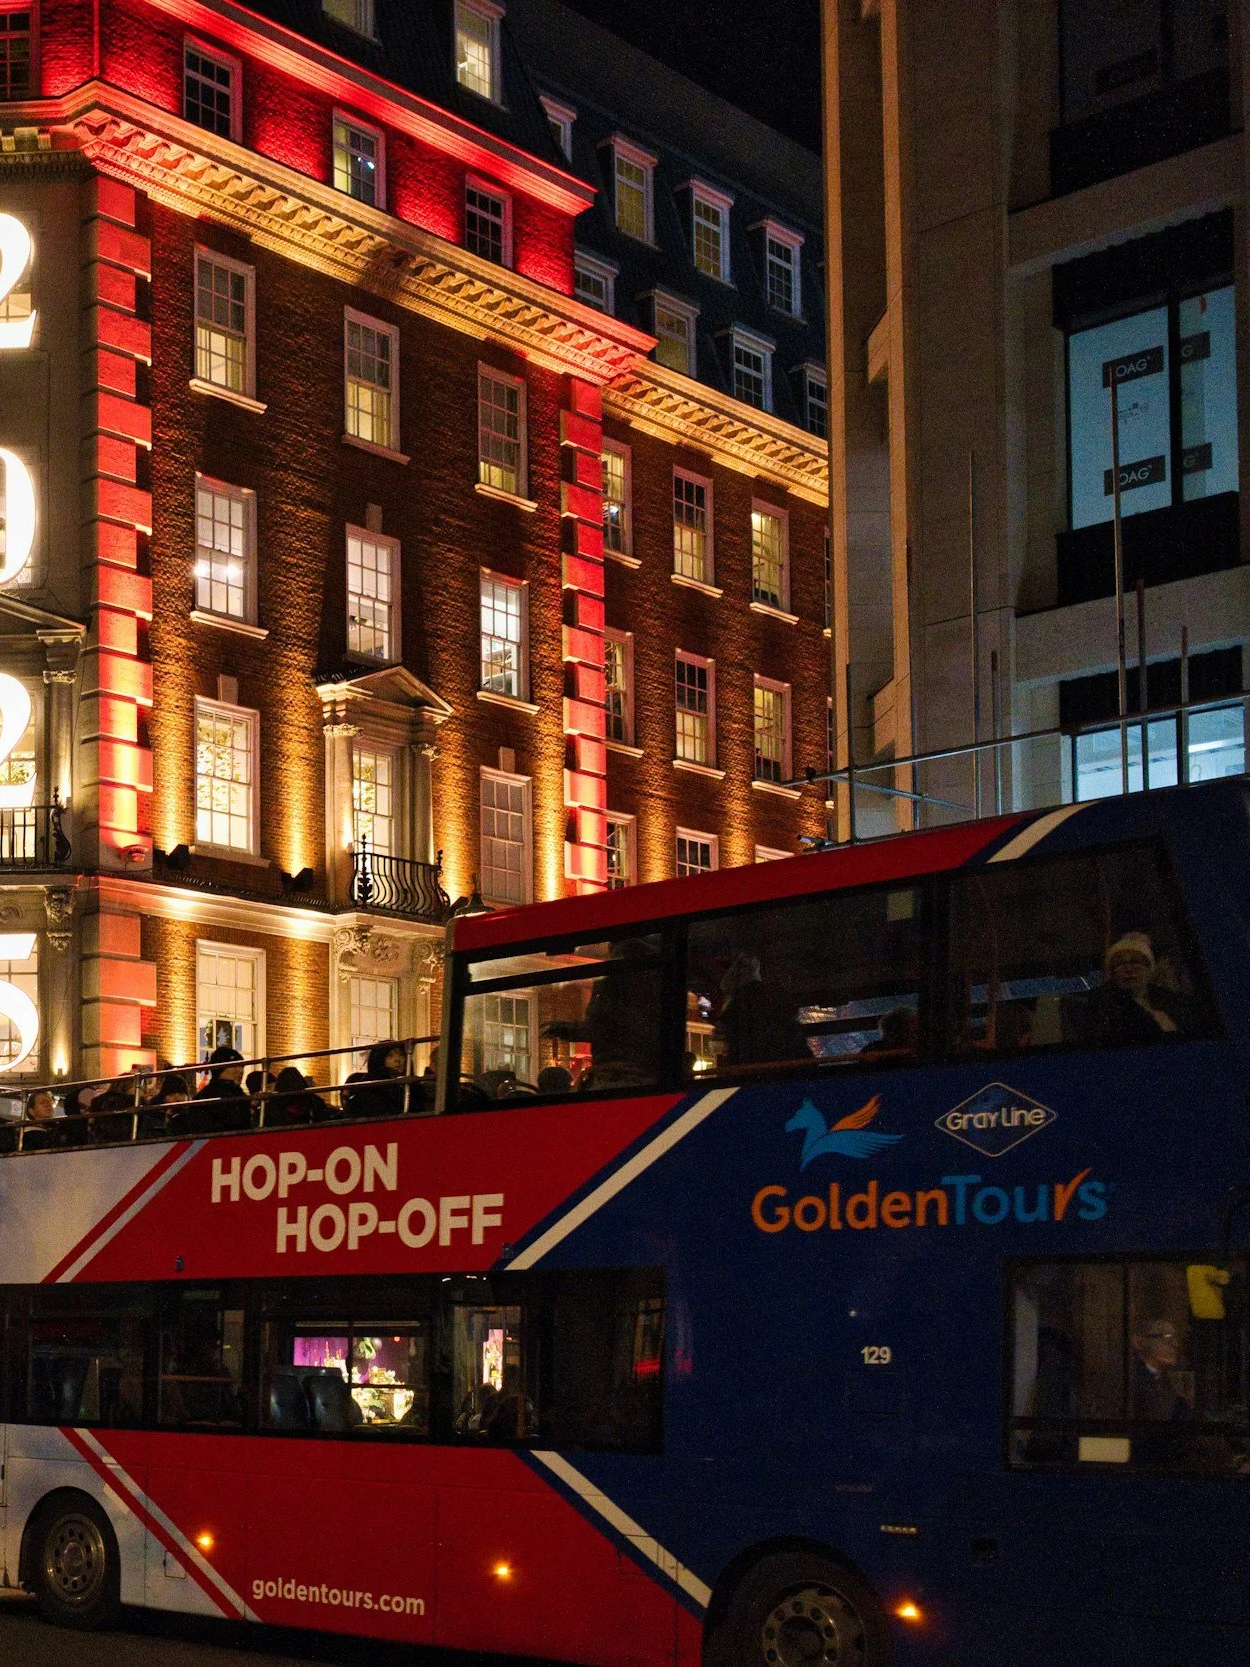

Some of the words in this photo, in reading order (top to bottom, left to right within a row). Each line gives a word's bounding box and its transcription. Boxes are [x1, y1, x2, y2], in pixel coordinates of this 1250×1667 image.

[1116, 358, 1148, 377] OAG
[211, 1142, 399, 1204] HOP-ON
[276, 1193, 505, 1253] HOP-OFF
[751, 1167, 1108, 1234] GoldenTours
[861, 1346, 892, 1365] 129
[252, 1577, 425, 1616] goldentours.com
